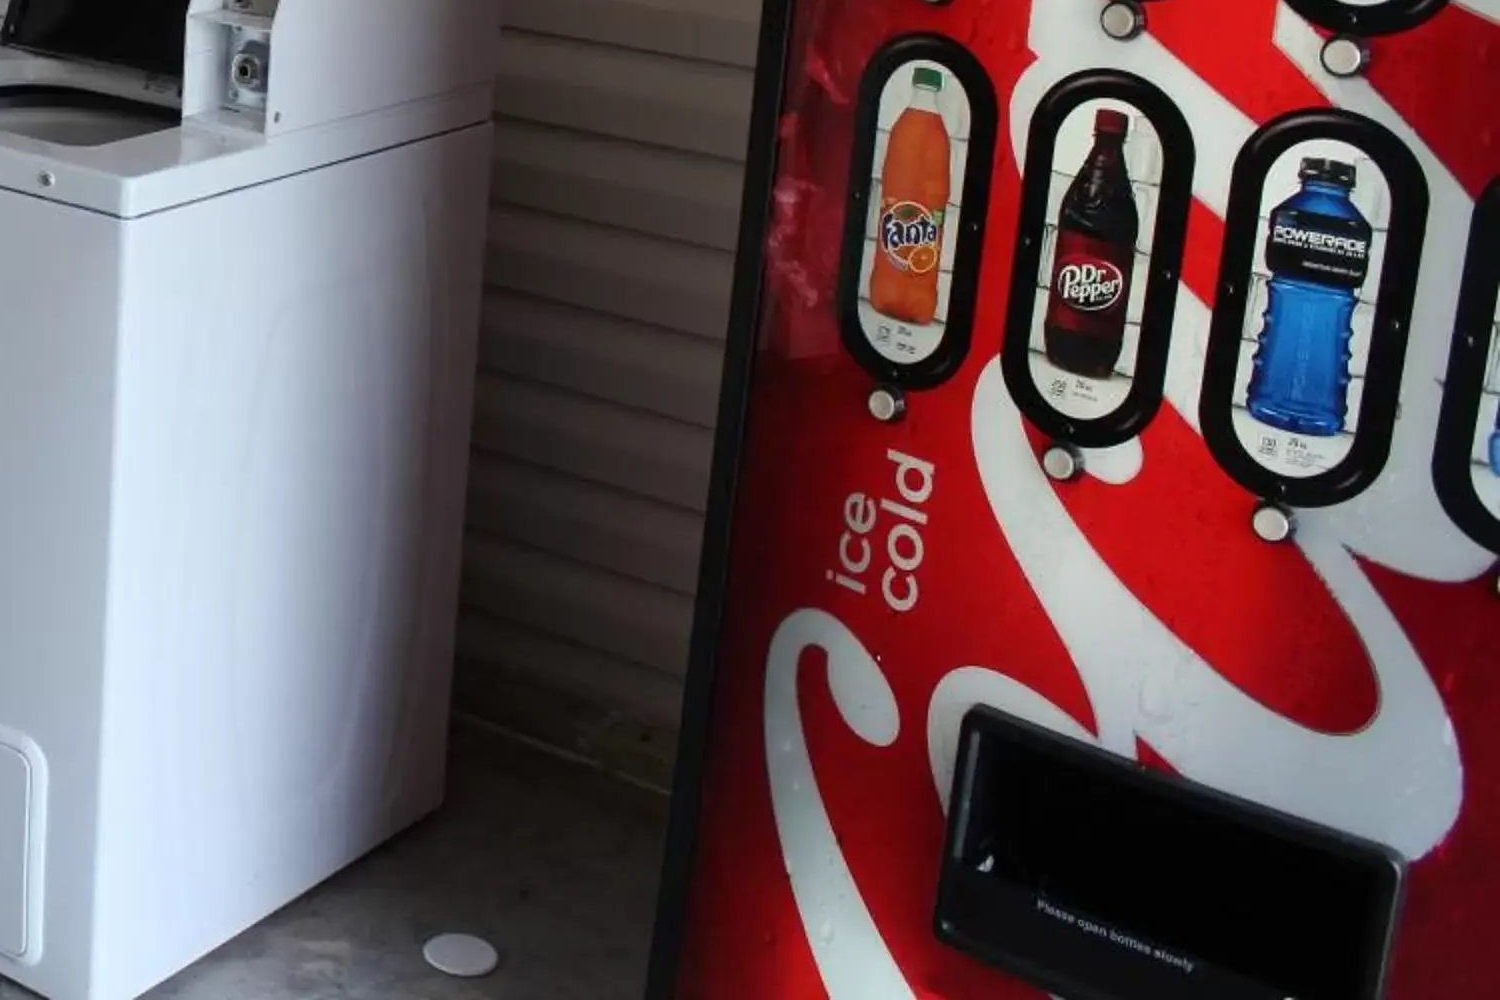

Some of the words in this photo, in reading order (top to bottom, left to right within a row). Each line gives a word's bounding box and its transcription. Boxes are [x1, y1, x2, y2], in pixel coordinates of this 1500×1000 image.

[1273, 225, 1366, 253] POWERADE
[1060, 265, 1119, 303] Pepper
[1081, 264, 1106, 283] Dr
[826, 492, 876, 595] ice
[880, 448, 935, 612] cold
[1037, 899, 1075, 923] Please
[1078, 918, 1107, 937] open
